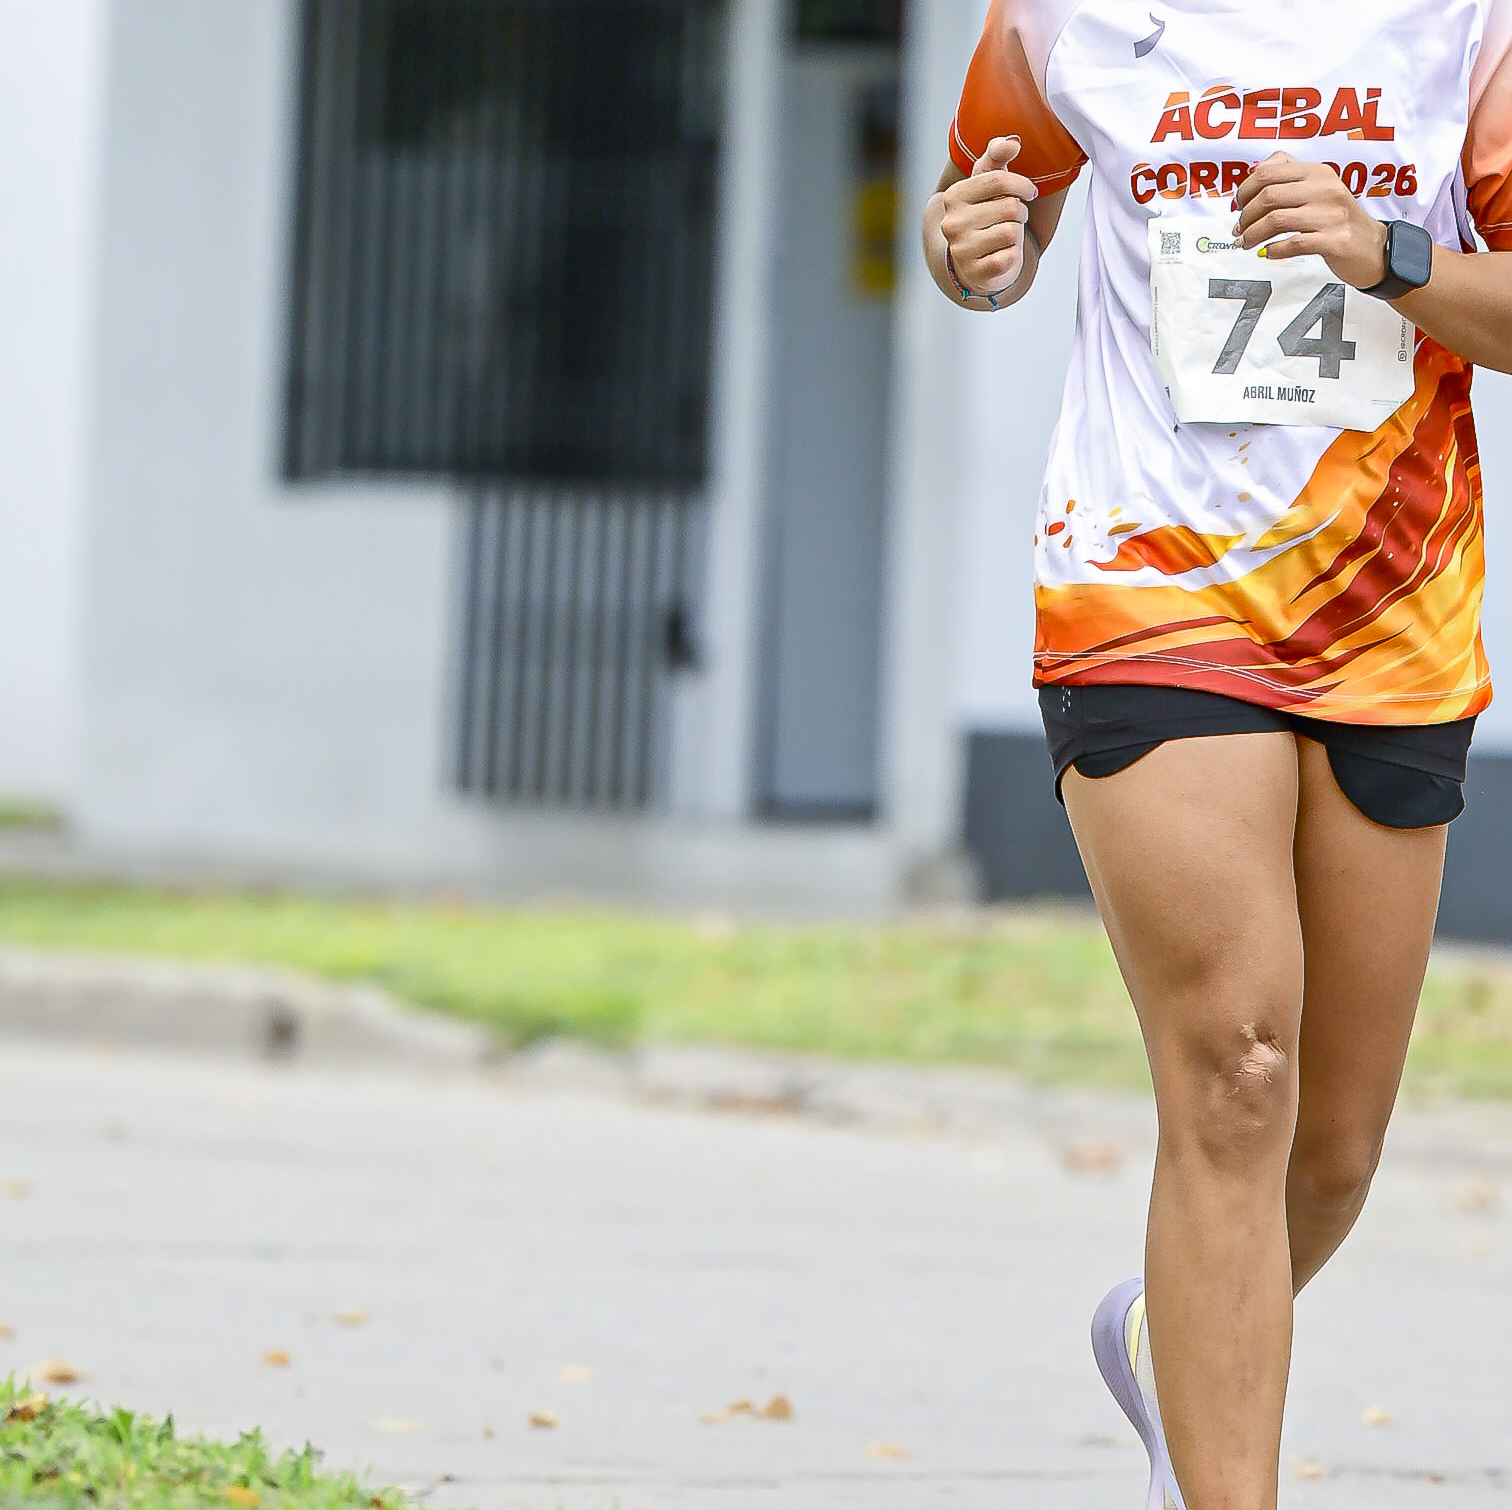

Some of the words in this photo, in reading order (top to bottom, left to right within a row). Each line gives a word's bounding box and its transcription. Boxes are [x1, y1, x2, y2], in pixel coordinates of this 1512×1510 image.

[1150, 85, 1395, 143] ACEBAL
[1130, 162, 1262, 205] CORR
[1321, 162, 1418, 198] 026
[1208, 278, 1357, 380] 74
[1243, 385, 1275, 400] ABRIL
[1277, 385, 1316, 403] MUÑOZ
